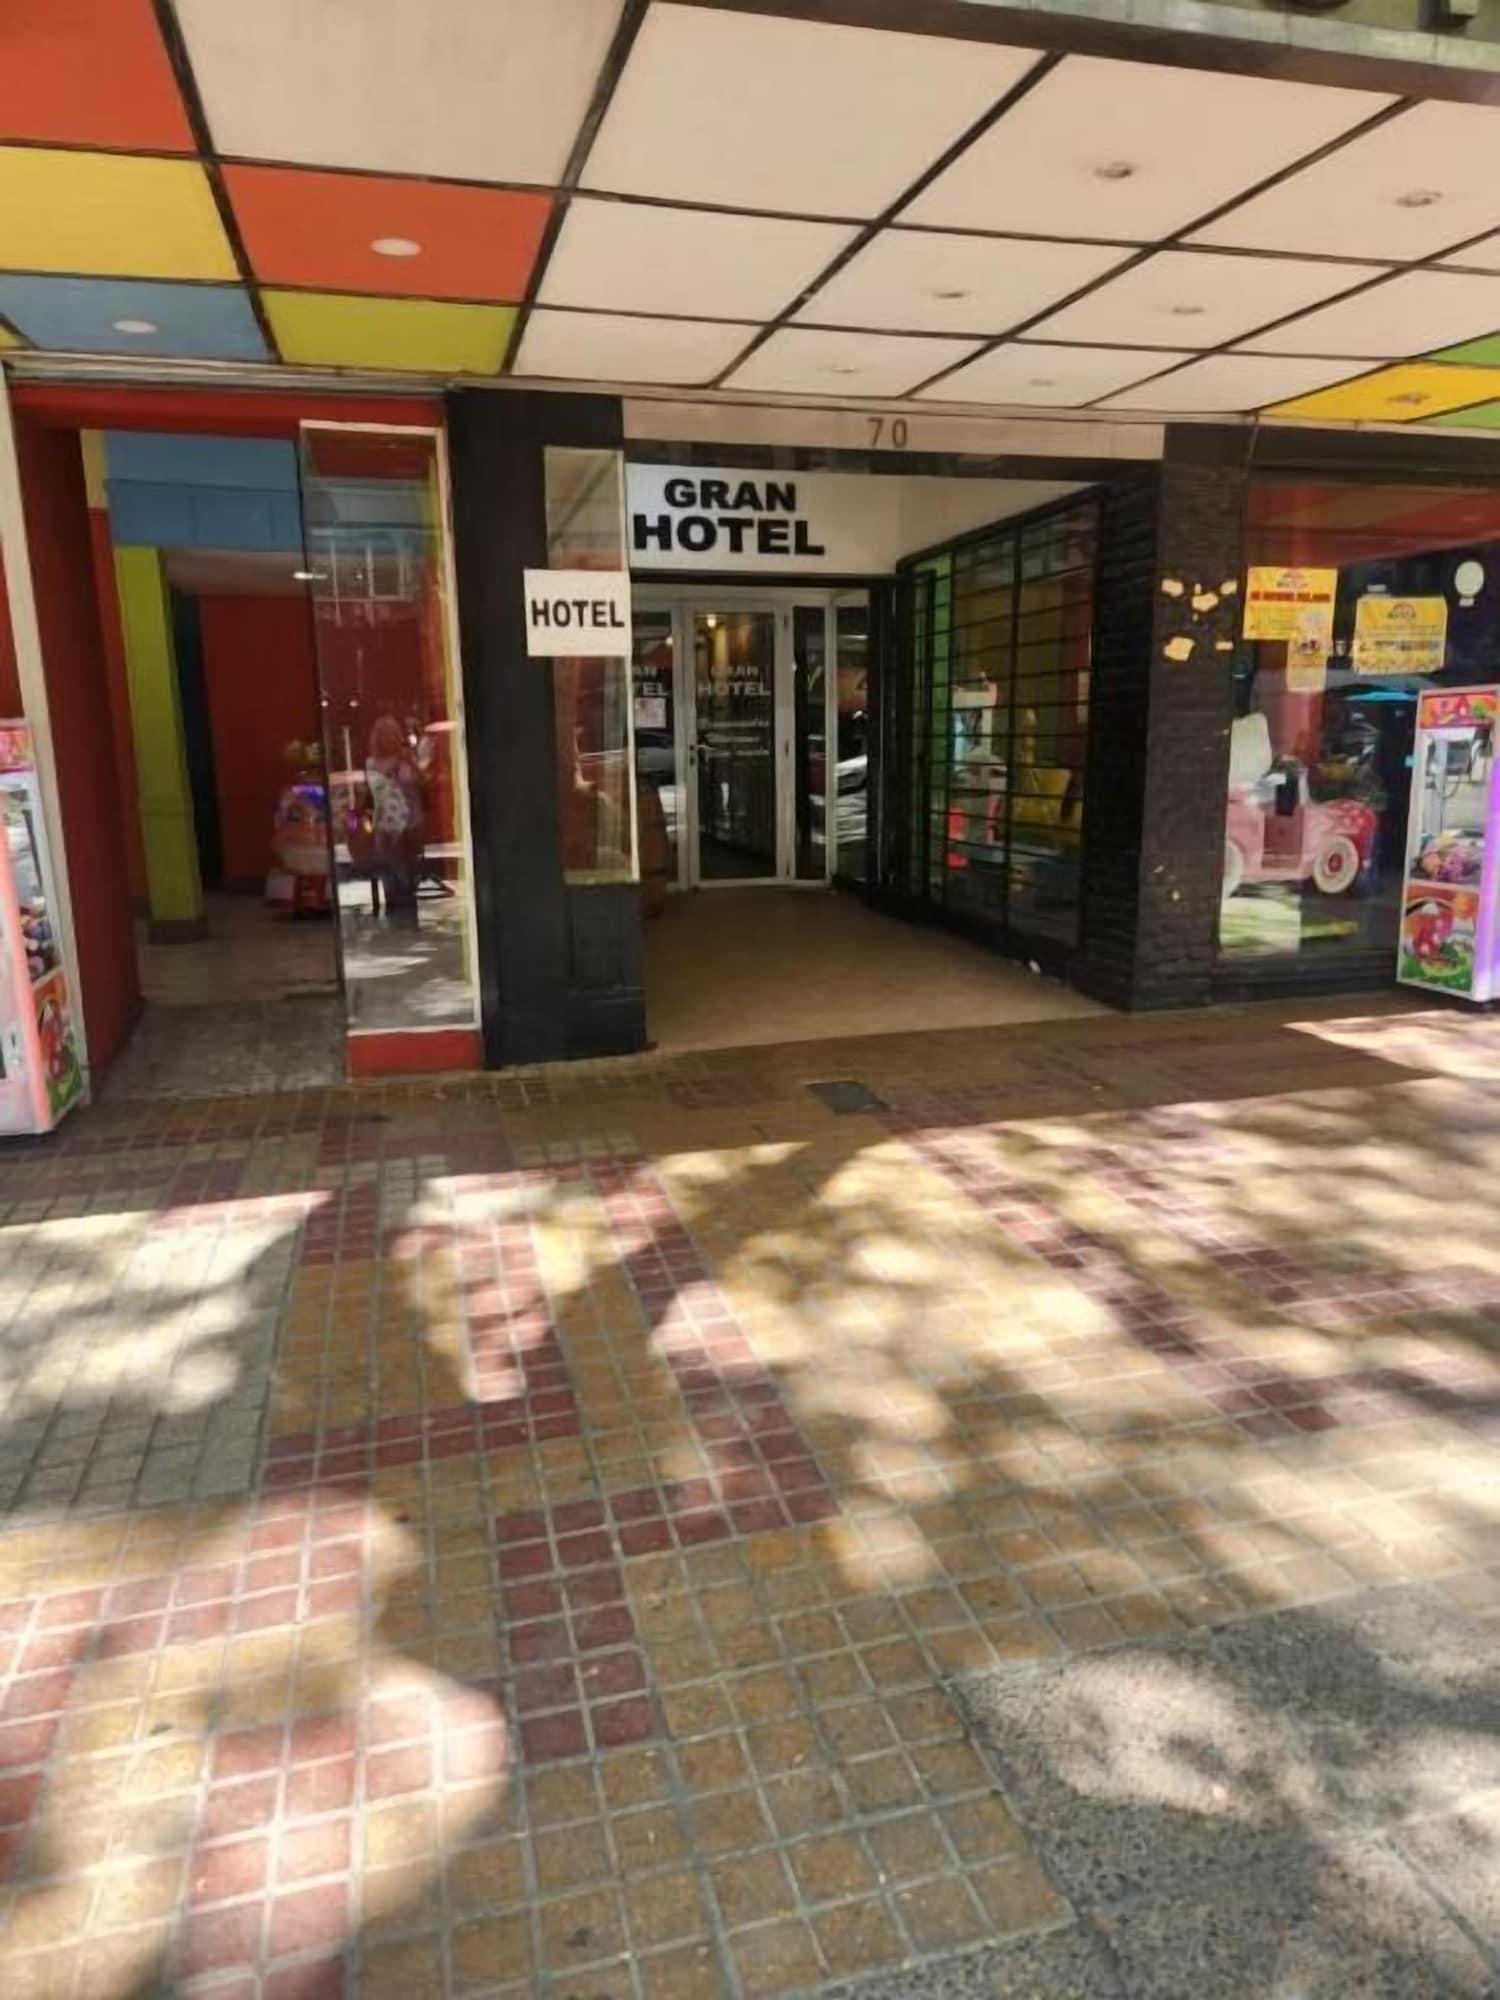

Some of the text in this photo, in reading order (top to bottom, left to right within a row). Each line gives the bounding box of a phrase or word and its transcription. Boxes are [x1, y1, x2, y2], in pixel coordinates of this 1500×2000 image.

[866, 416, 908, 449] 70
[664, 478, 796, 512] GRAN
[633, 514, 825, 556] HOTEL
[531, 599, 625, 627] HOTEL
